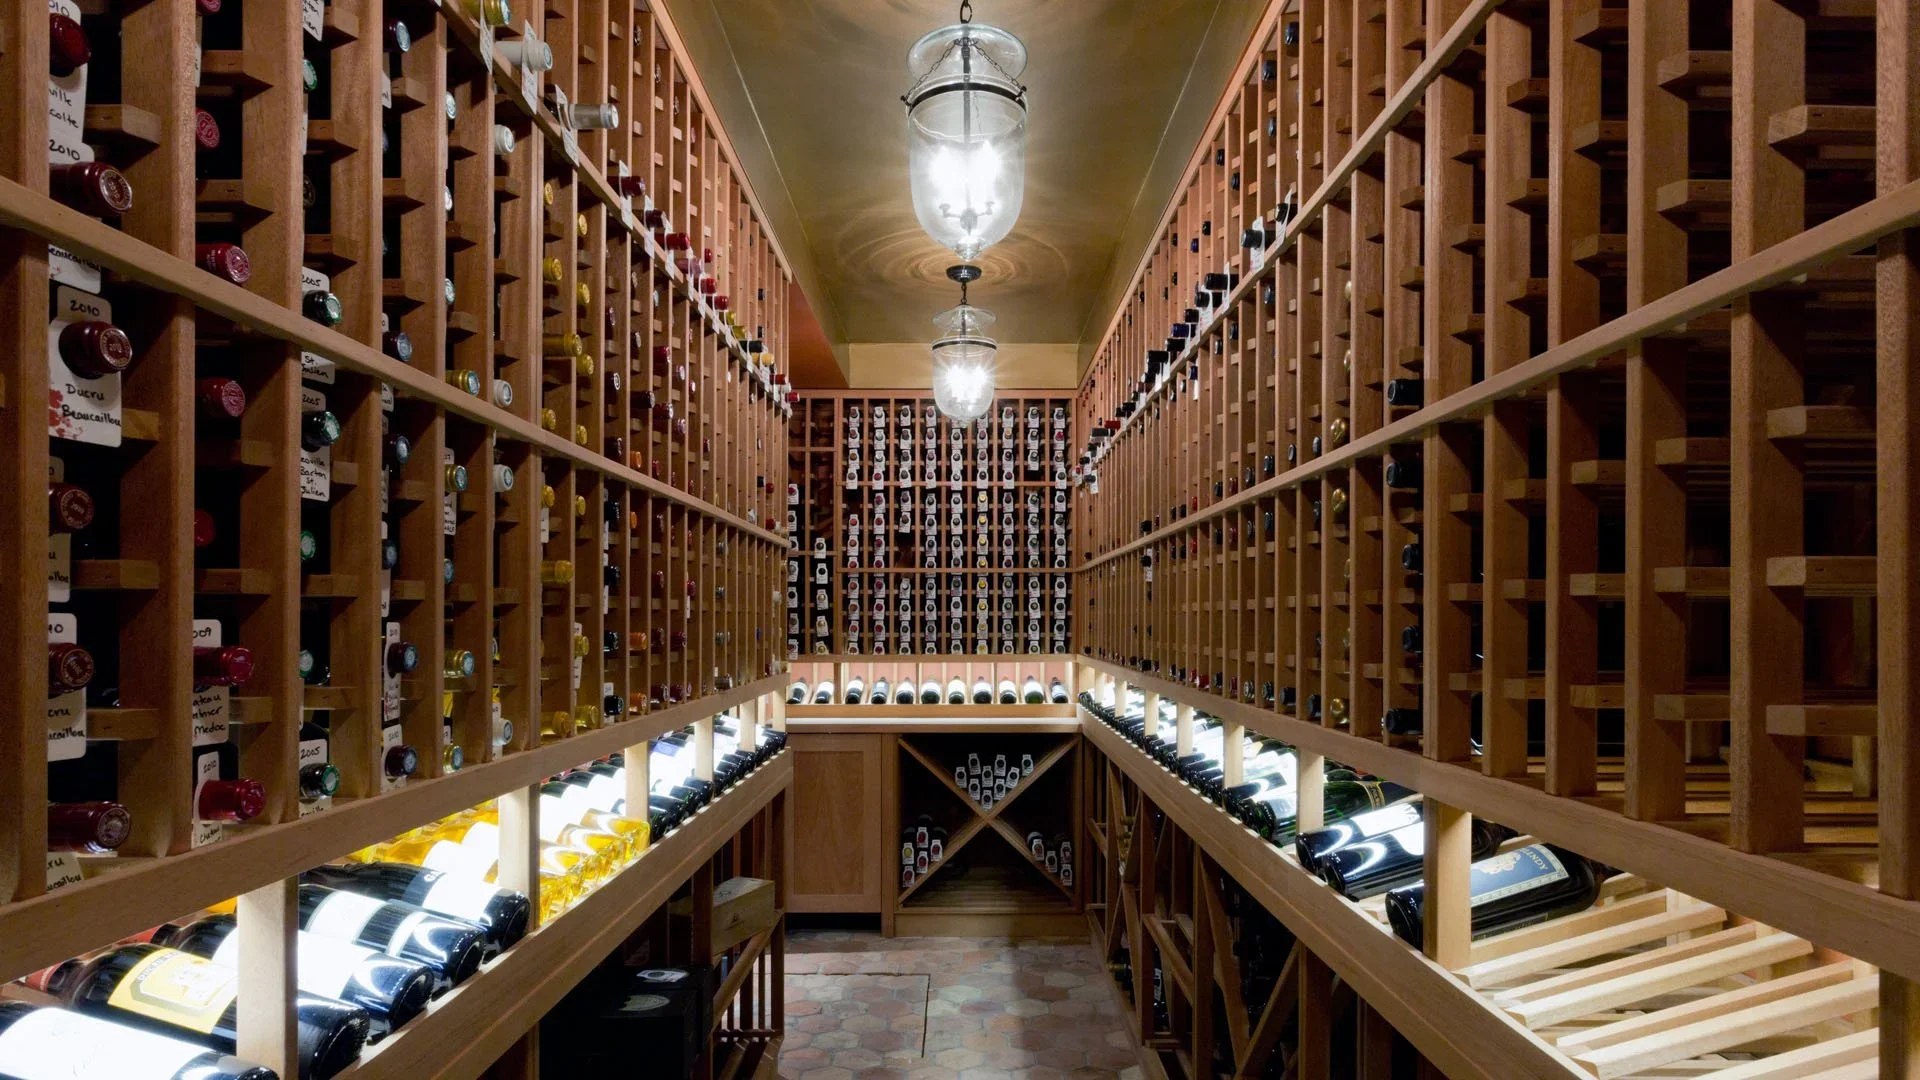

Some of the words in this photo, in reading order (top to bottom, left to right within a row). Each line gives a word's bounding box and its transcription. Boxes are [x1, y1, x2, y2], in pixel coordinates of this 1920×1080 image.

[49, 139, 80, 160] 2010
[70, 299, 100, 317] 2010
[65, 383, 105, 401] Ducru
[61, 404, 122, 427] Beaucaillou
[194, 722, 226, 736] Medoc
[300, 746, 321, 760] 2005
